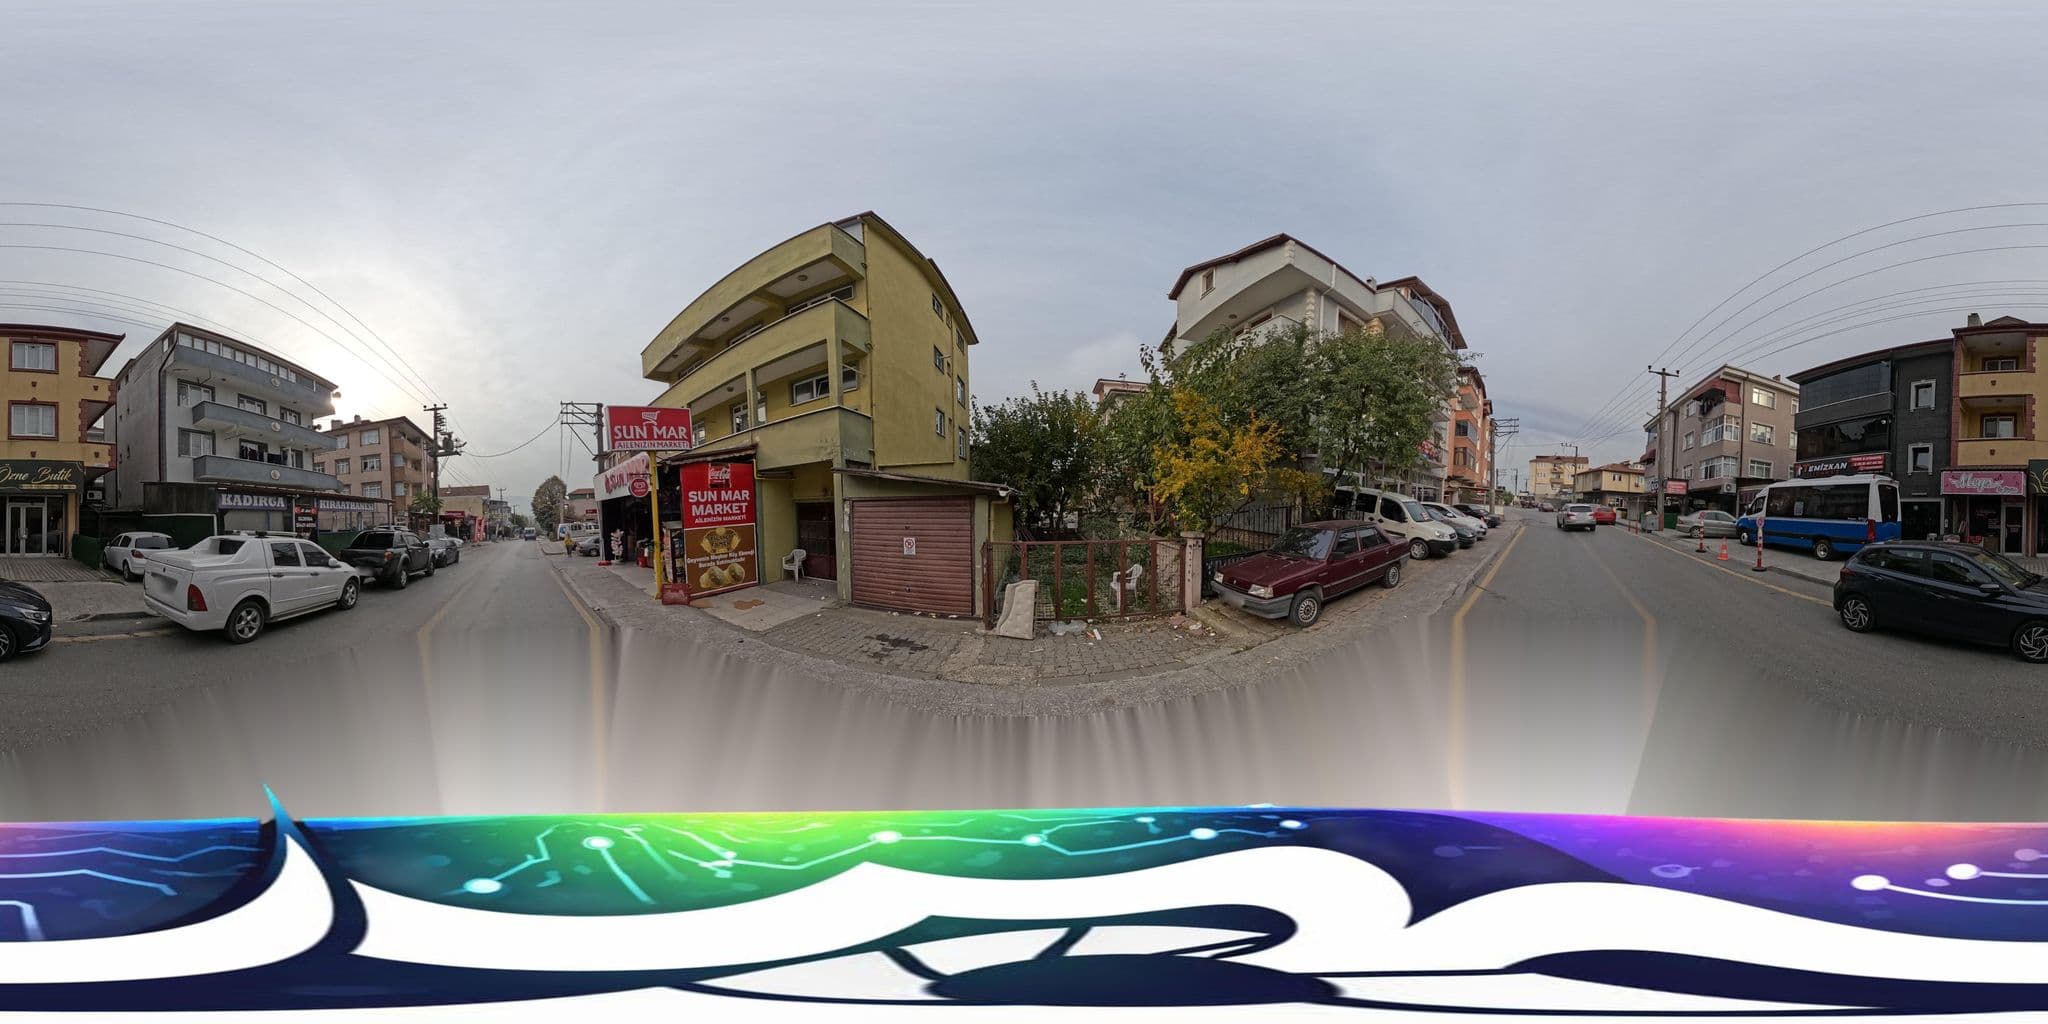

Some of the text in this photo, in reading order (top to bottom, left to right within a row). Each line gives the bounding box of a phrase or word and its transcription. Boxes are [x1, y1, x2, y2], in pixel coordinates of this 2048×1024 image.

[614, 426, 688, 440] SUN MAR
[1803, 462, 1848, 473] TEMİZKAN
[221, 493, 285, 508] KADIRGA
[688, 489, 750, 503] SUN MAR
[691, 502, 748, 516] MARKET
